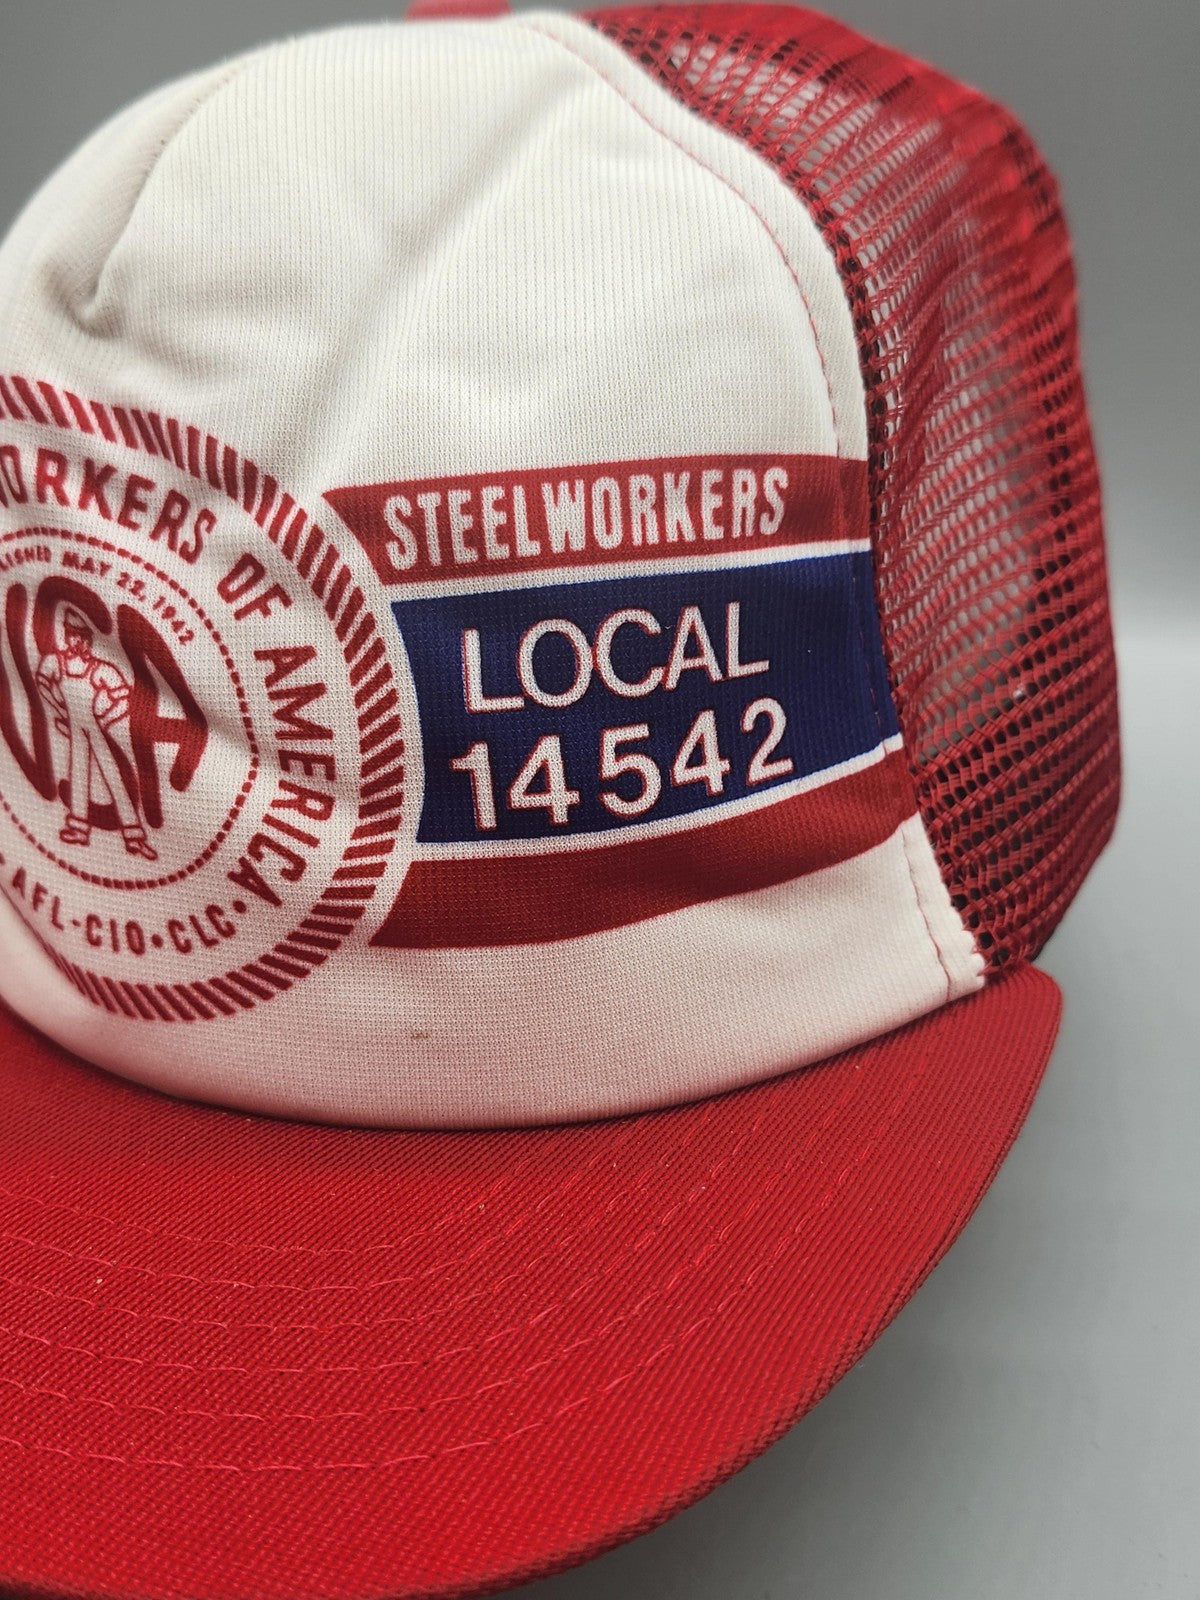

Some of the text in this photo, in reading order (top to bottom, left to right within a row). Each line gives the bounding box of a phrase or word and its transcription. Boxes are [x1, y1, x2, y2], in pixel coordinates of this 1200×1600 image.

[383, 467, 789, 571] STEELWORKERS
[62, 550, 112, 577] MAY
[153, 595, 195, 645] 1942
[0, 443, 337, 907] ORKERS OF AMERICA
[461, 601, 771, 714] LOCAL
[449, 697, 795, 832] 14542
